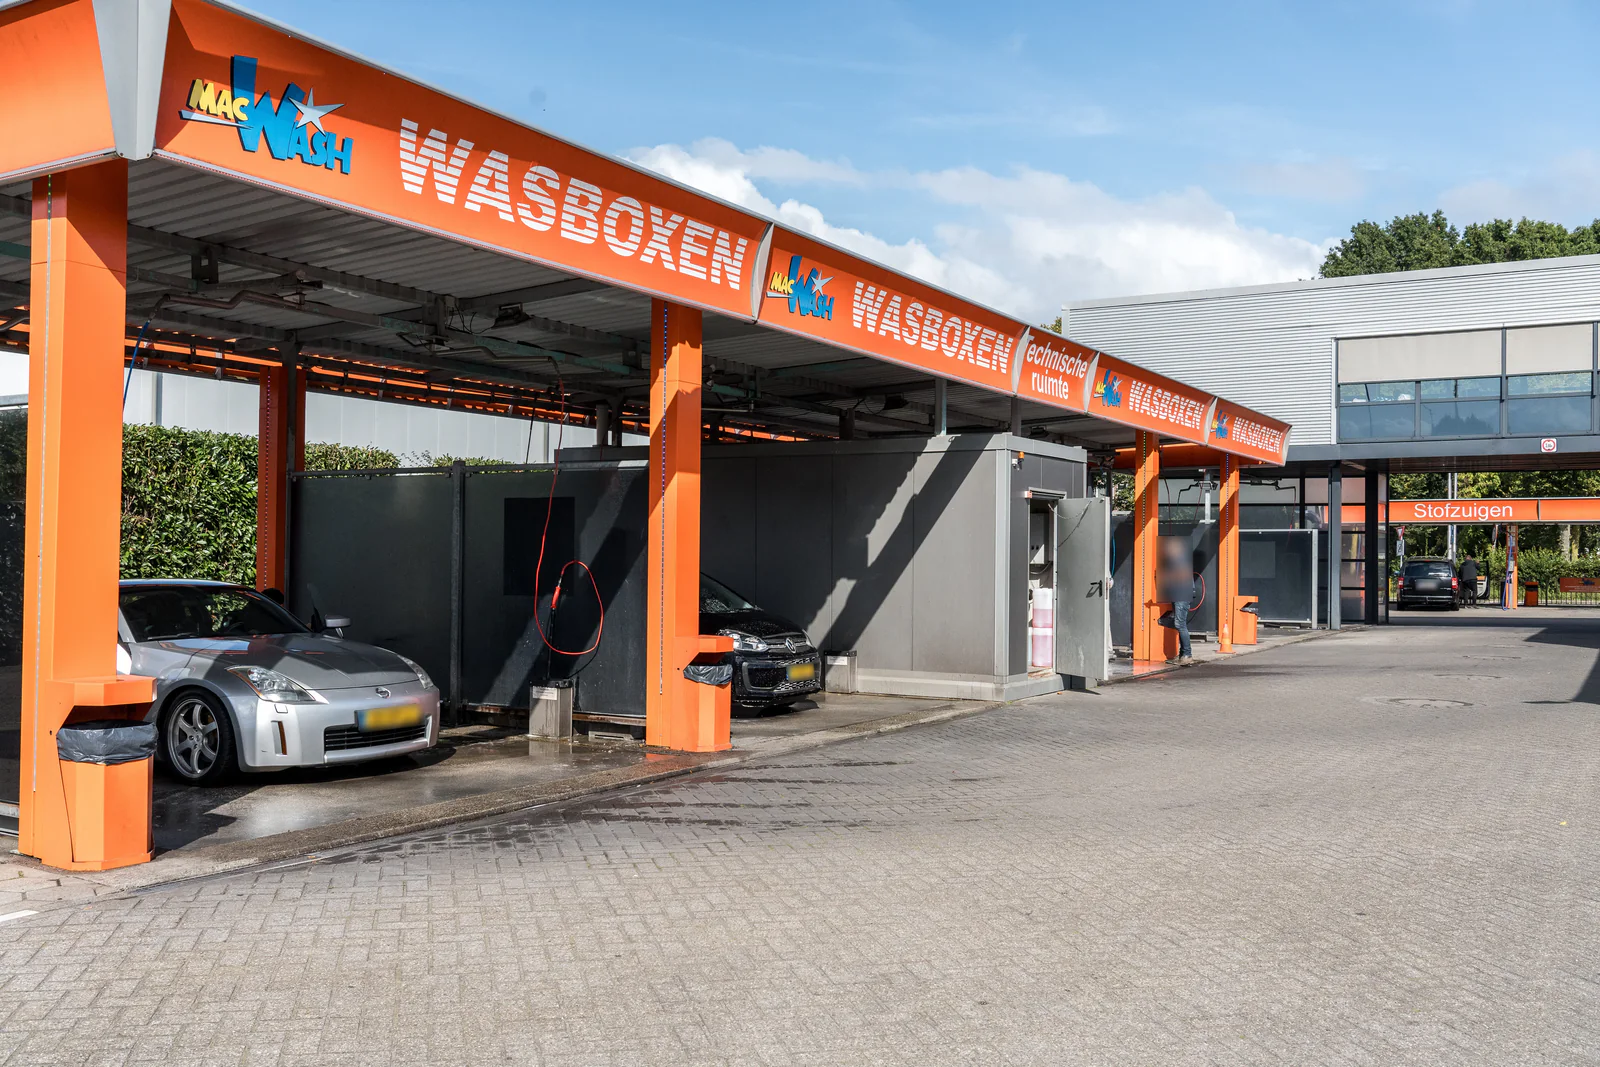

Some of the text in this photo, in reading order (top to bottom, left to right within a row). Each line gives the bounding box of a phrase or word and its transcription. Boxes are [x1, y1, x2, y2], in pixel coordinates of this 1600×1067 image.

[187, 54, 354, 174] MAC WASH
[400, 117, 748, 290] WASBOXEN
[770, 271, 795, 294] MAC
[852, 281, 1014, 374] WASBOXEN
[1032, 369, 1069, 400] ruimte
[1128, 380, 1205, 430] WASBOXEN
[1232, 416, 1283, 453] WASBOXEN
[1414, 502, 1513, 522] Stofzuigen
